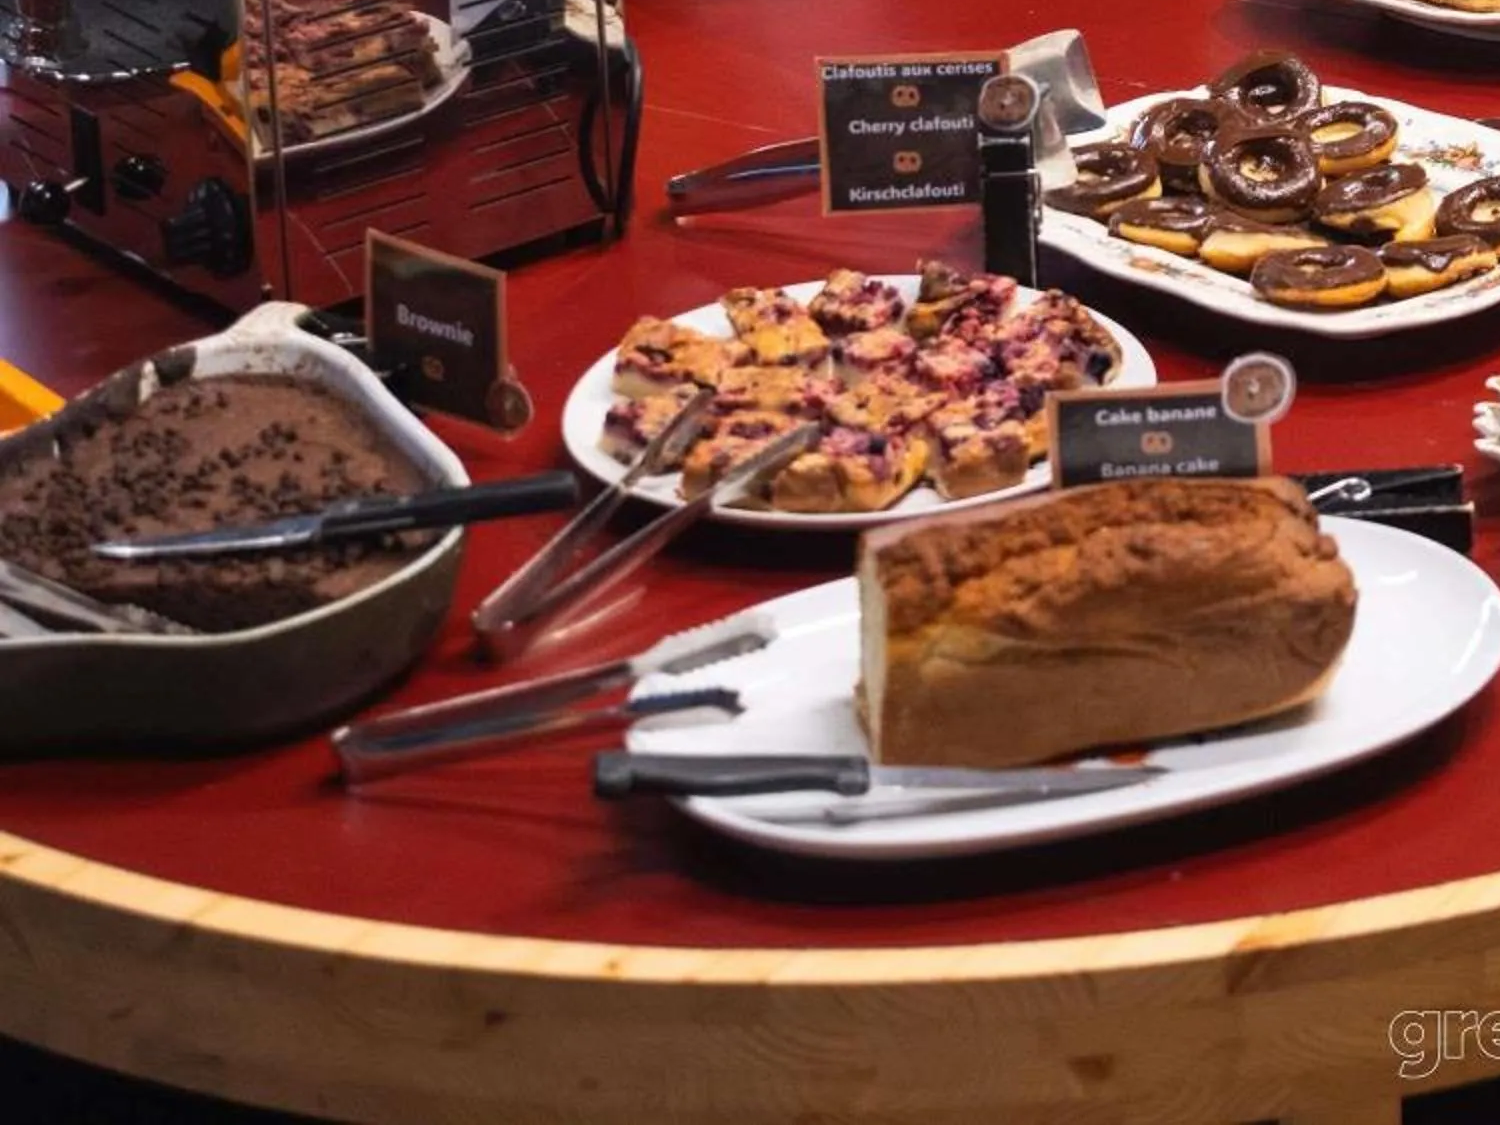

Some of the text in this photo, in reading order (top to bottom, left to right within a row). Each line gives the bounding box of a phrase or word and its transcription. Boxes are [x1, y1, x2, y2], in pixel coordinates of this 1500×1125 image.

[821, 61, 994, 81] Clafoutis aux cerises
[849, 115, 975, 136] Cherry clafouti
[849, 182, 966, 203] Kirschclafouti
[396, 302, 475, 347] Brownie
[1095, 405, 1218, 426] Cake banane
[1101, 456, 1220, 478] Banana cake
